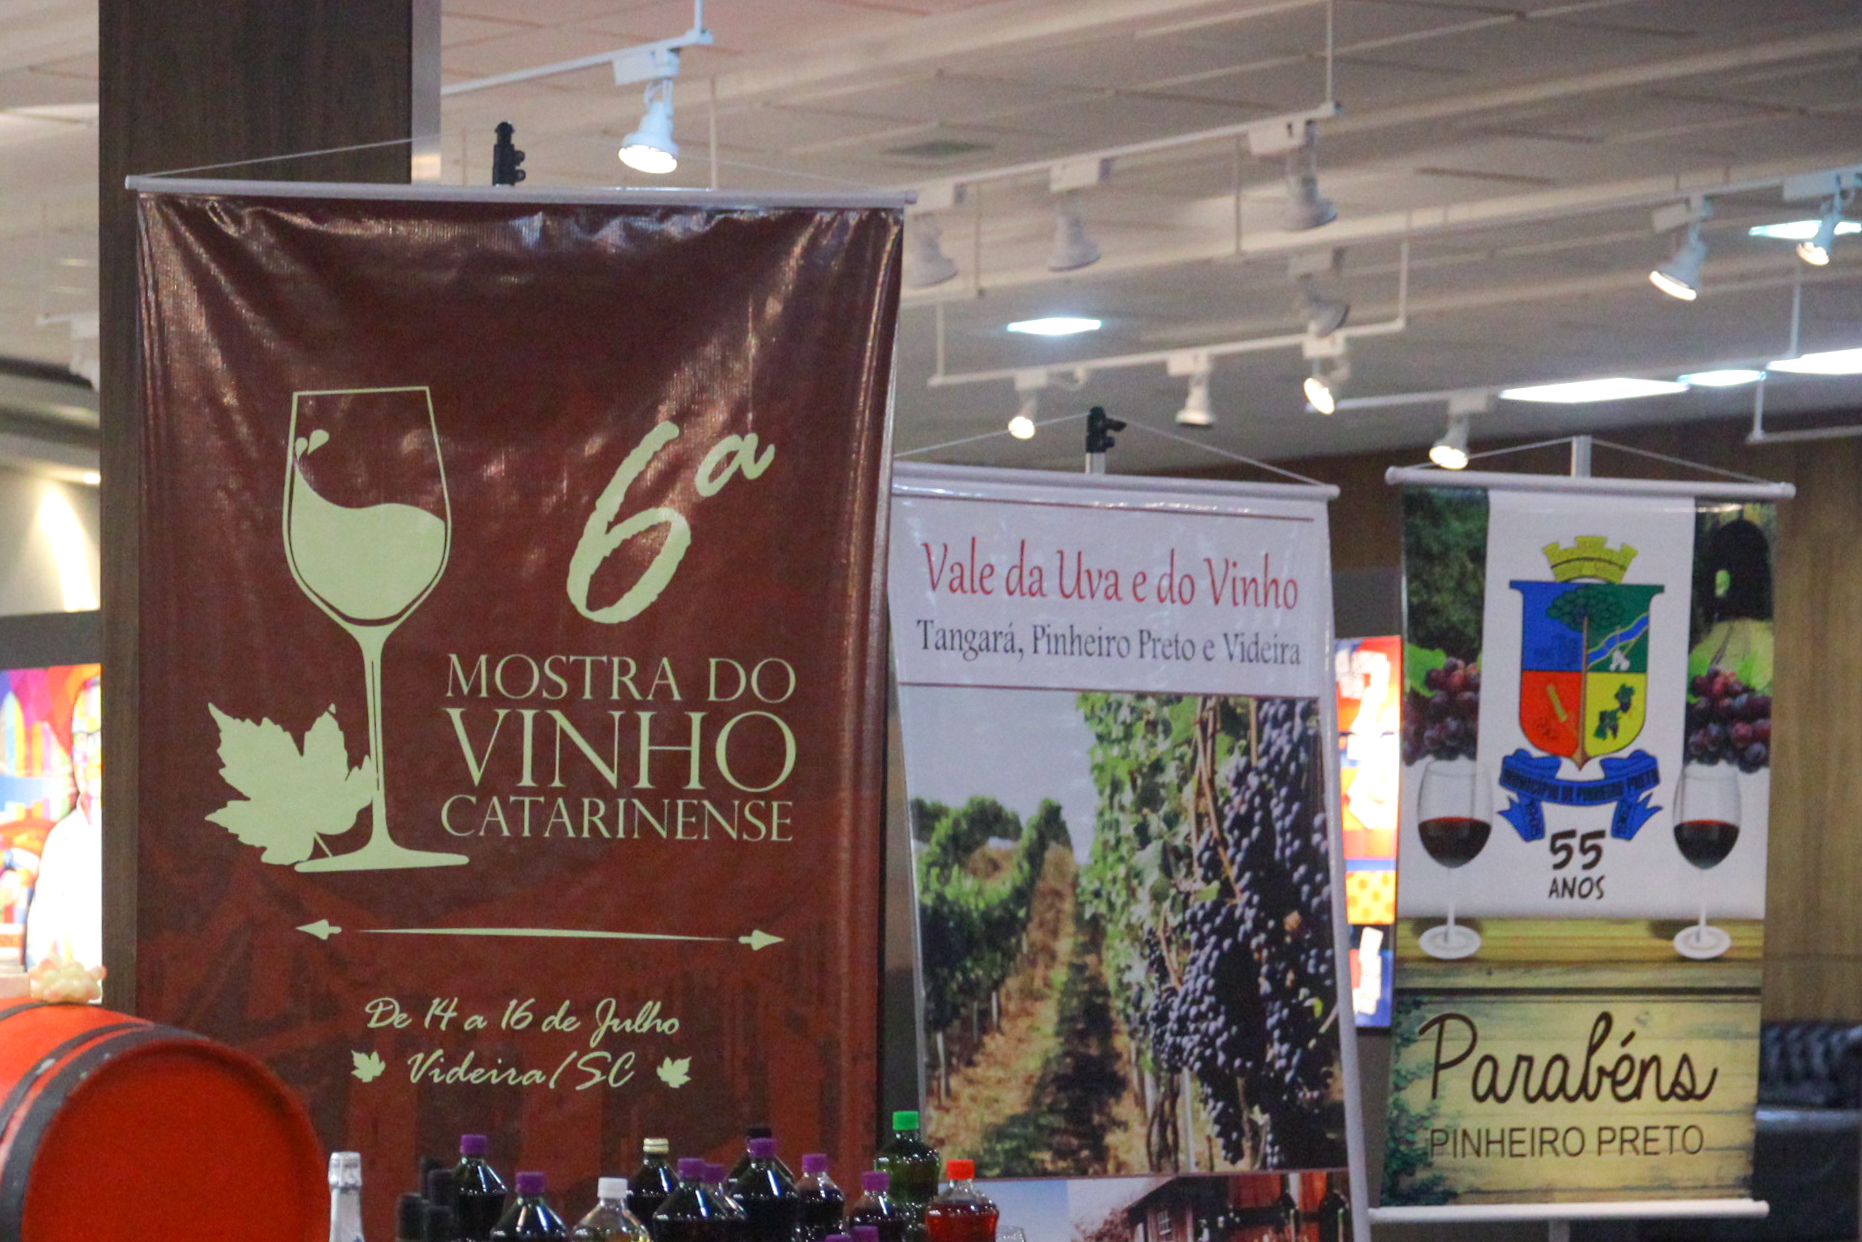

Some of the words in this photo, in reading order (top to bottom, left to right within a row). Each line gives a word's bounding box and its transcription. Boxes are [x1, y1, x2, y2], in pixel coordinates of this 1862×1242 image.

[921, 536, 995, 596] Vale
[1005, 539, 1047, 598] da
[1056, 549, 1122, 601] Uva
[1132, 570, 1148, 603] e
[1157, 548, 1196, 605] do
[1203, 552, 1299, 610] Vinho
[916, 619, 1024, 662] Tangará,
[1032, 624, 1130, 660] Pinheiro
[1138, 629, 1195, 662] Preto
[1202, 639, 1216, 662] e
[1223, 632, 1301, 665] Videira
[445, 653, 682, 701] MOSTRA
[707, 657, 797, 704] DO
[441, 707, 798, 793] VINHO
[440, 794, 794, 842] CATARINENSE
[1549, 829, 1606, 870] 55
[1548, 875, 1606, 900] ANOS
[364, 996, 412, 1029] De
[424, 996, 458, 1031] 14
[463, 1012, 487, 1031] a
[500, 997, 536, 1031] 16
[541, 999, 581, 1033] de
[589, 997, 680, 1049] Julho
[407, 1048, 636, 1092] Videira/SC
[1418, 1011, 1718, 1104] Parabéns
[1430, 1126, 1586, 1159] PINHEIRO
[1597, 1125, 1705, 1157] PRETO
